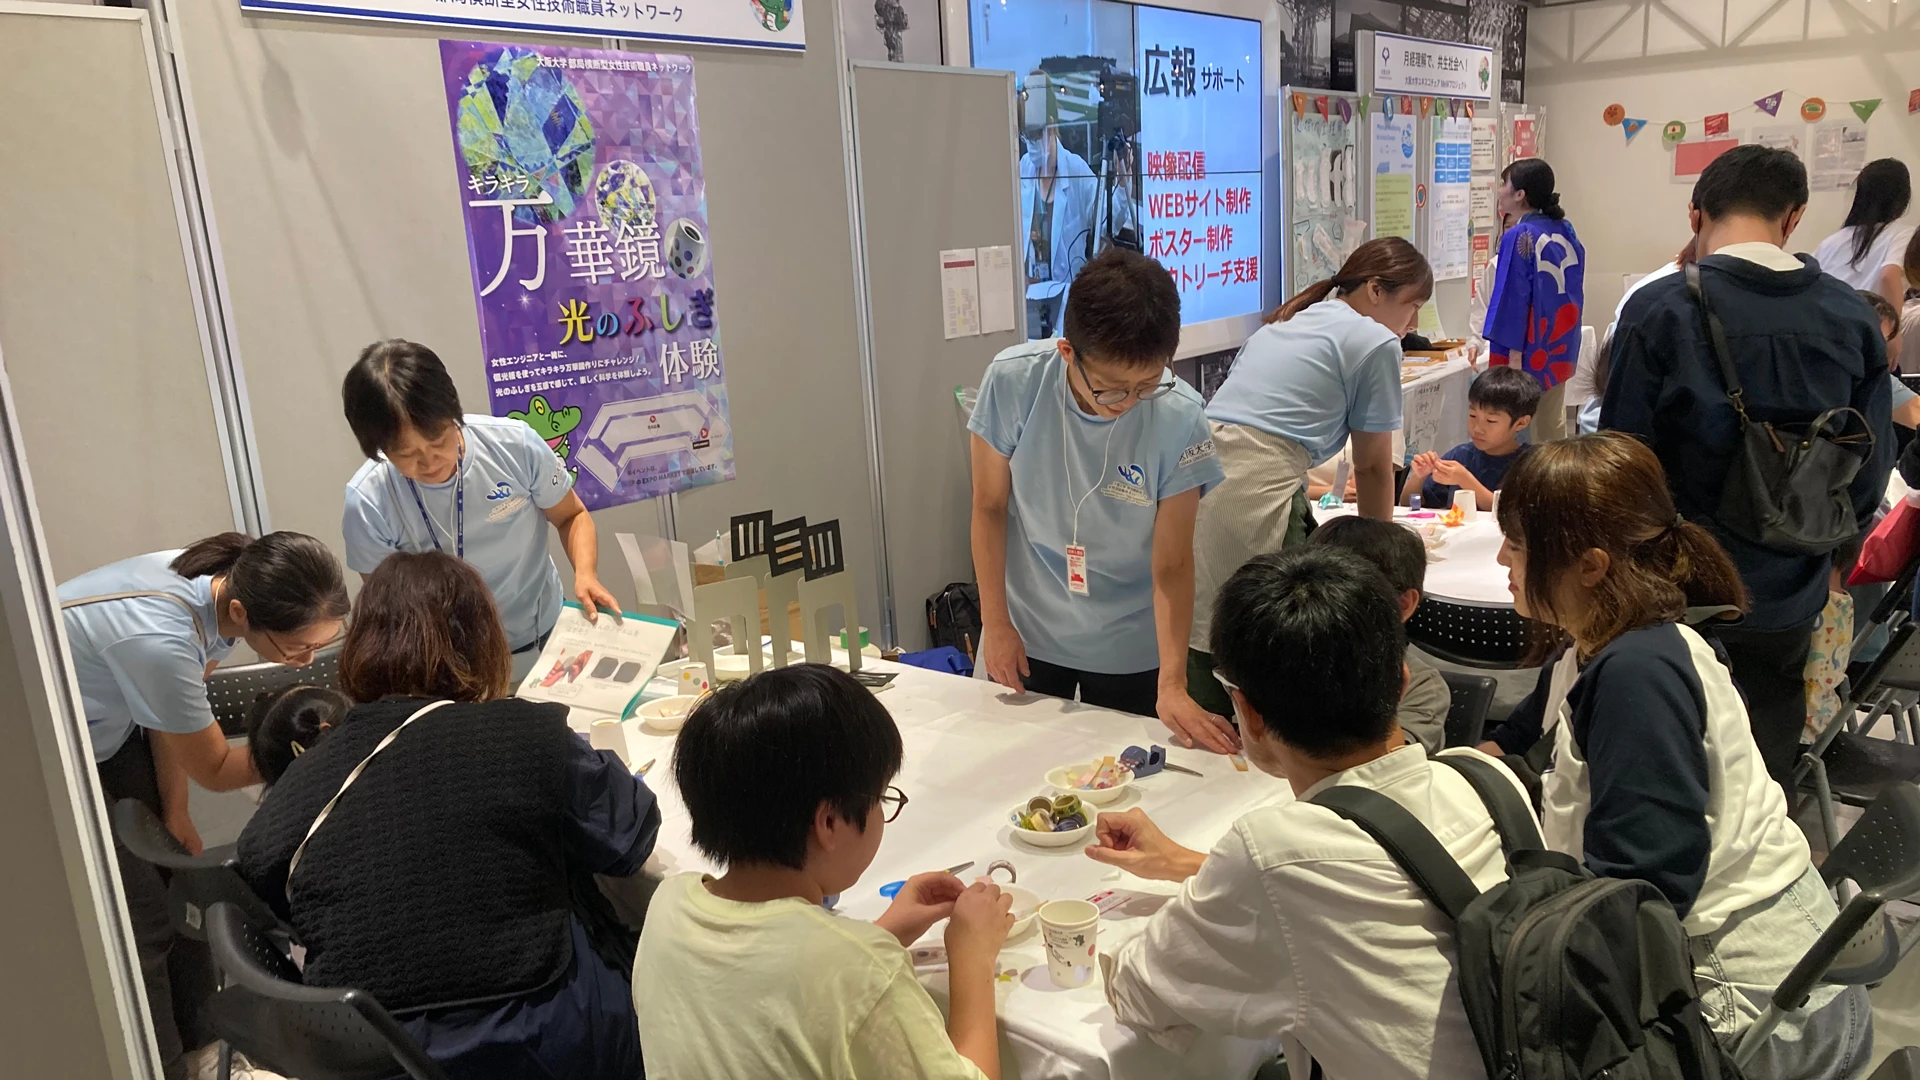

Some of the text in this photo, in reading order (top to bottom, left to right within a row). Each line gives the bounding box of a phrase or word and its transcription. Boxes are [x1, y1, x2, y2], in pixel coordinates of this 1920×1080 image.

[436, 0, 683, 22] 型女性技術職員ネットワーク
[536, 55, 567, 68] 大阪大学
[1143, 43, 1245, 98] 広報 サポート
[1147, 150, 1206, 182] 映像配信
[467, 173, 530, 195] キラキラ
[1148, 186, 1252, 220] WEBサイト制作
[468, 190, 667, 297] 万華鏡
[1149, 223, 1234, 259] ポスター制作
[557, 287, 715, 346] 光のふしぎ
[490, 350, 568, 368] 女性エンジニアと一緒に、
[658, 337, 721, 386] 体験
